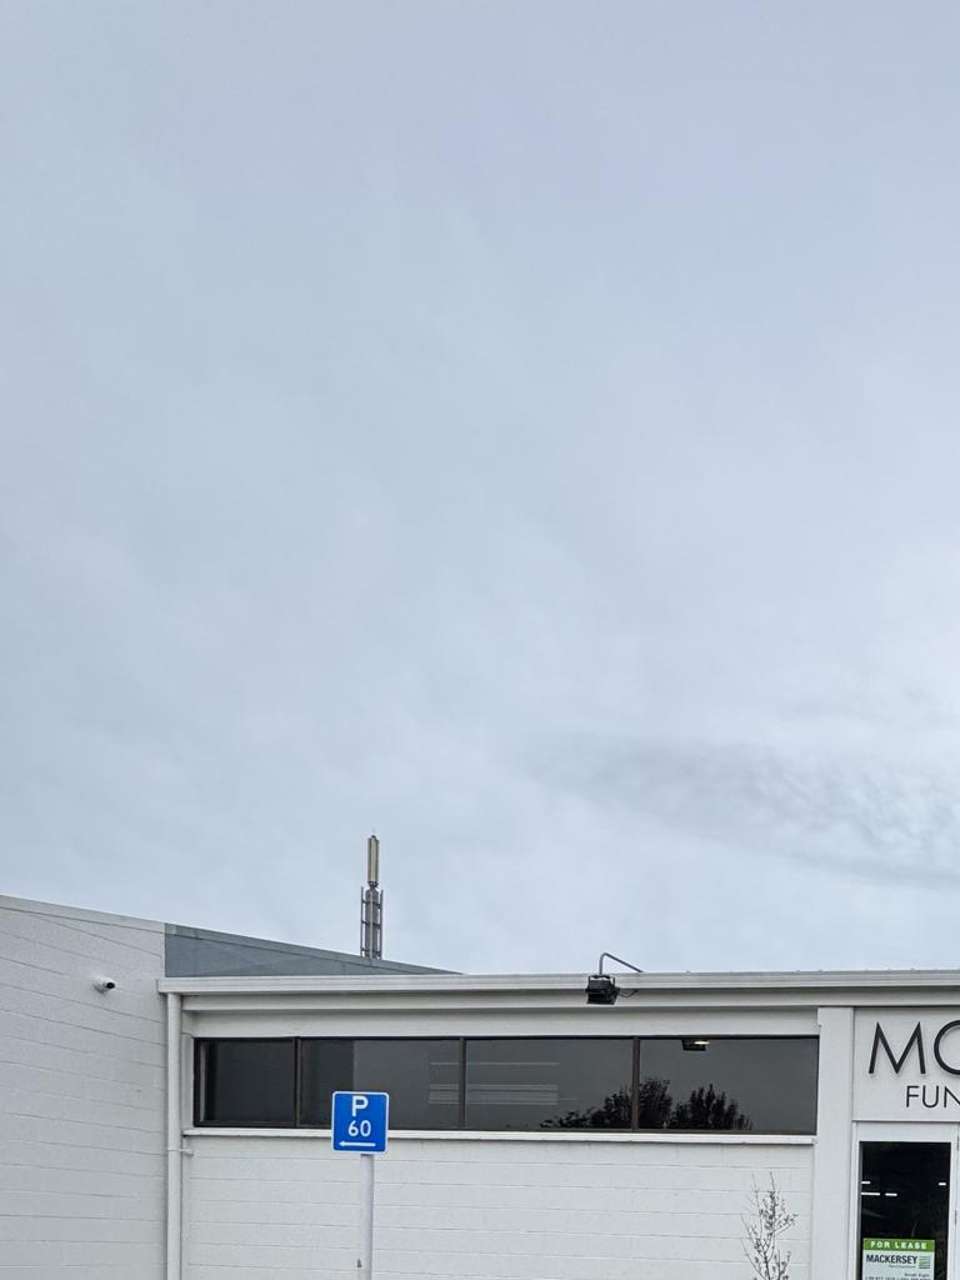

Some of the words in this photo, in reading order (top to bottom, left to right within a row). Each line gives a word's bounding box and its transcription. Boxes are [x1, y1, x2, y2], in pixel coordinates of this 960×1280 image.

[352, 1095, 369, 1117] P
[348, 1119, 371, 1137] 60
[870, 1240, 891, 1249] FOR
[894, 1241, 928, 1250] LEASE
[865, 1254, 918, 1265] MACKERSEY
